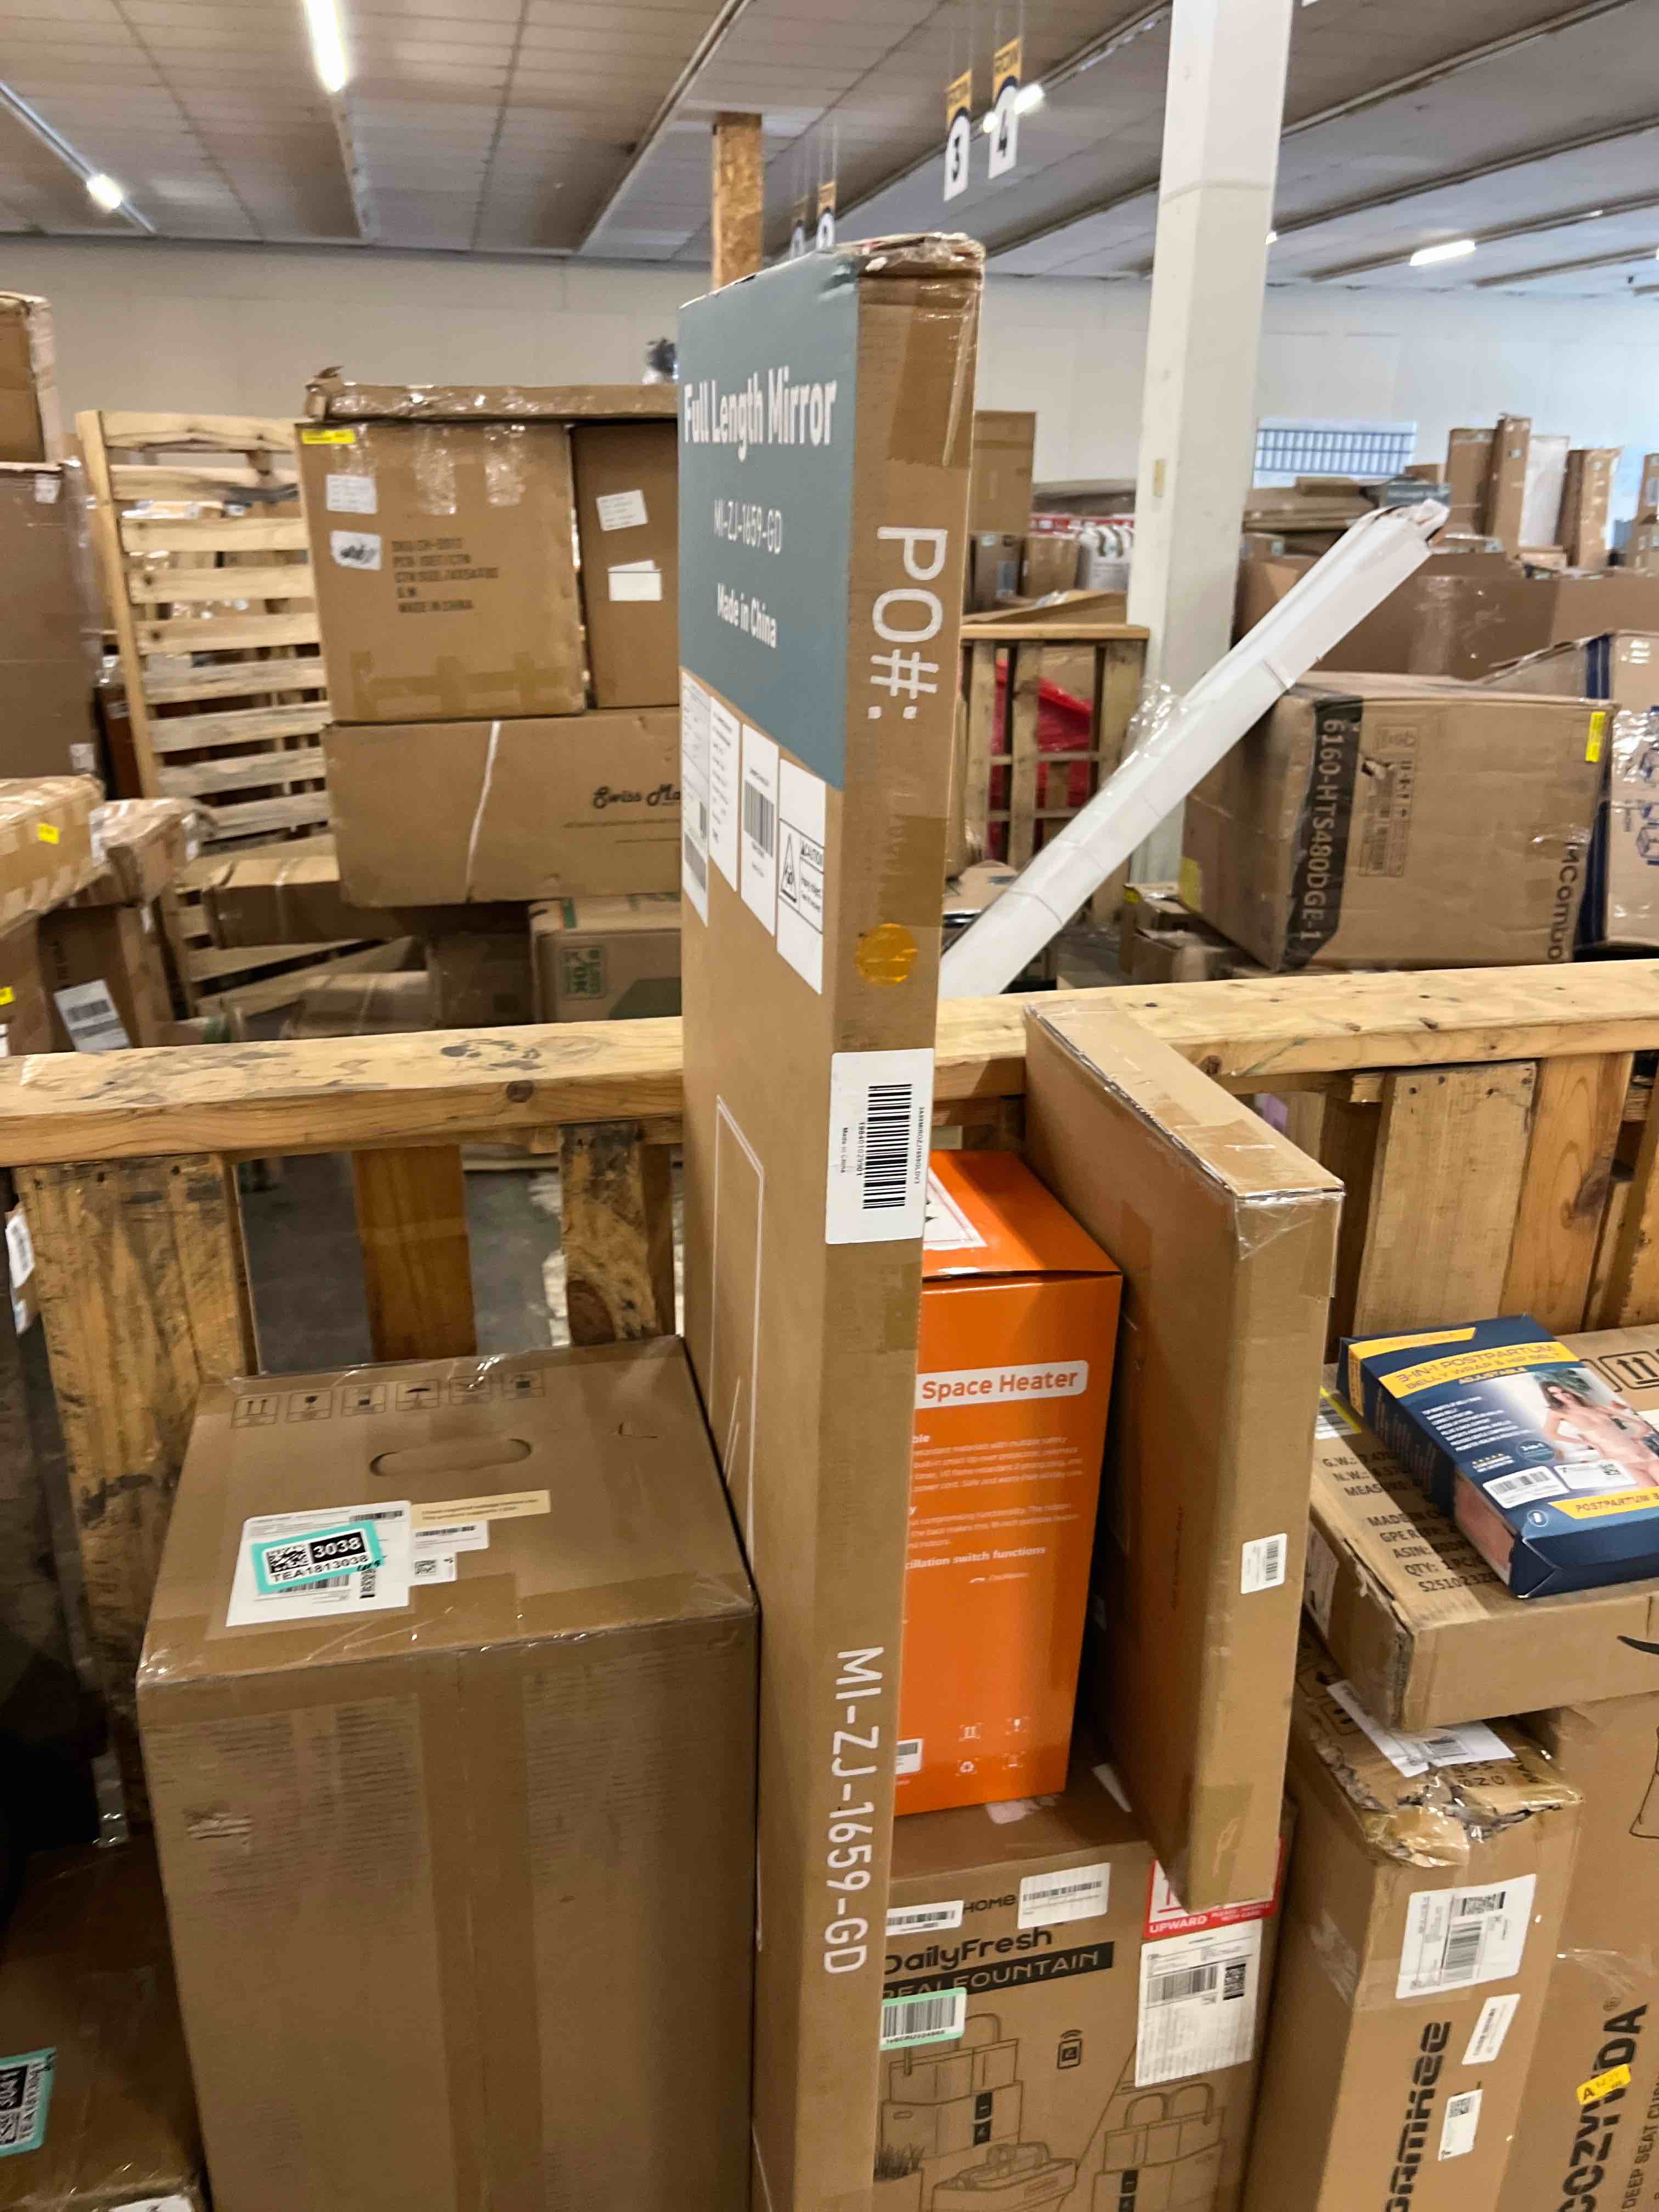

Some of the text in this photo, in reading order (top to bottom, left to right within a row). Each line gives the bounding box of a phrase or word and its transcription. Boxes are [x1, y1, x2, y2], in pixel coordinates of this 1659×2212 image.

[684, 365, 837, 462] Full Length Mirror
[717, 582, 777, 649] Made in China
[1440, 1344, 1555, 1369] POSTPARTUM
[922, 1370, 1079, 1402] Space Heater
[313, 1537, 361, 1559] 3038
[992, 1545, 1047, 1559] functions
[270, 1555, 369, 1582] TEA1813038
[824, 1646, 884, 1974] MI-ZJ-1659-GD
[1149, 1915, 1207, 1933] UPWARD
